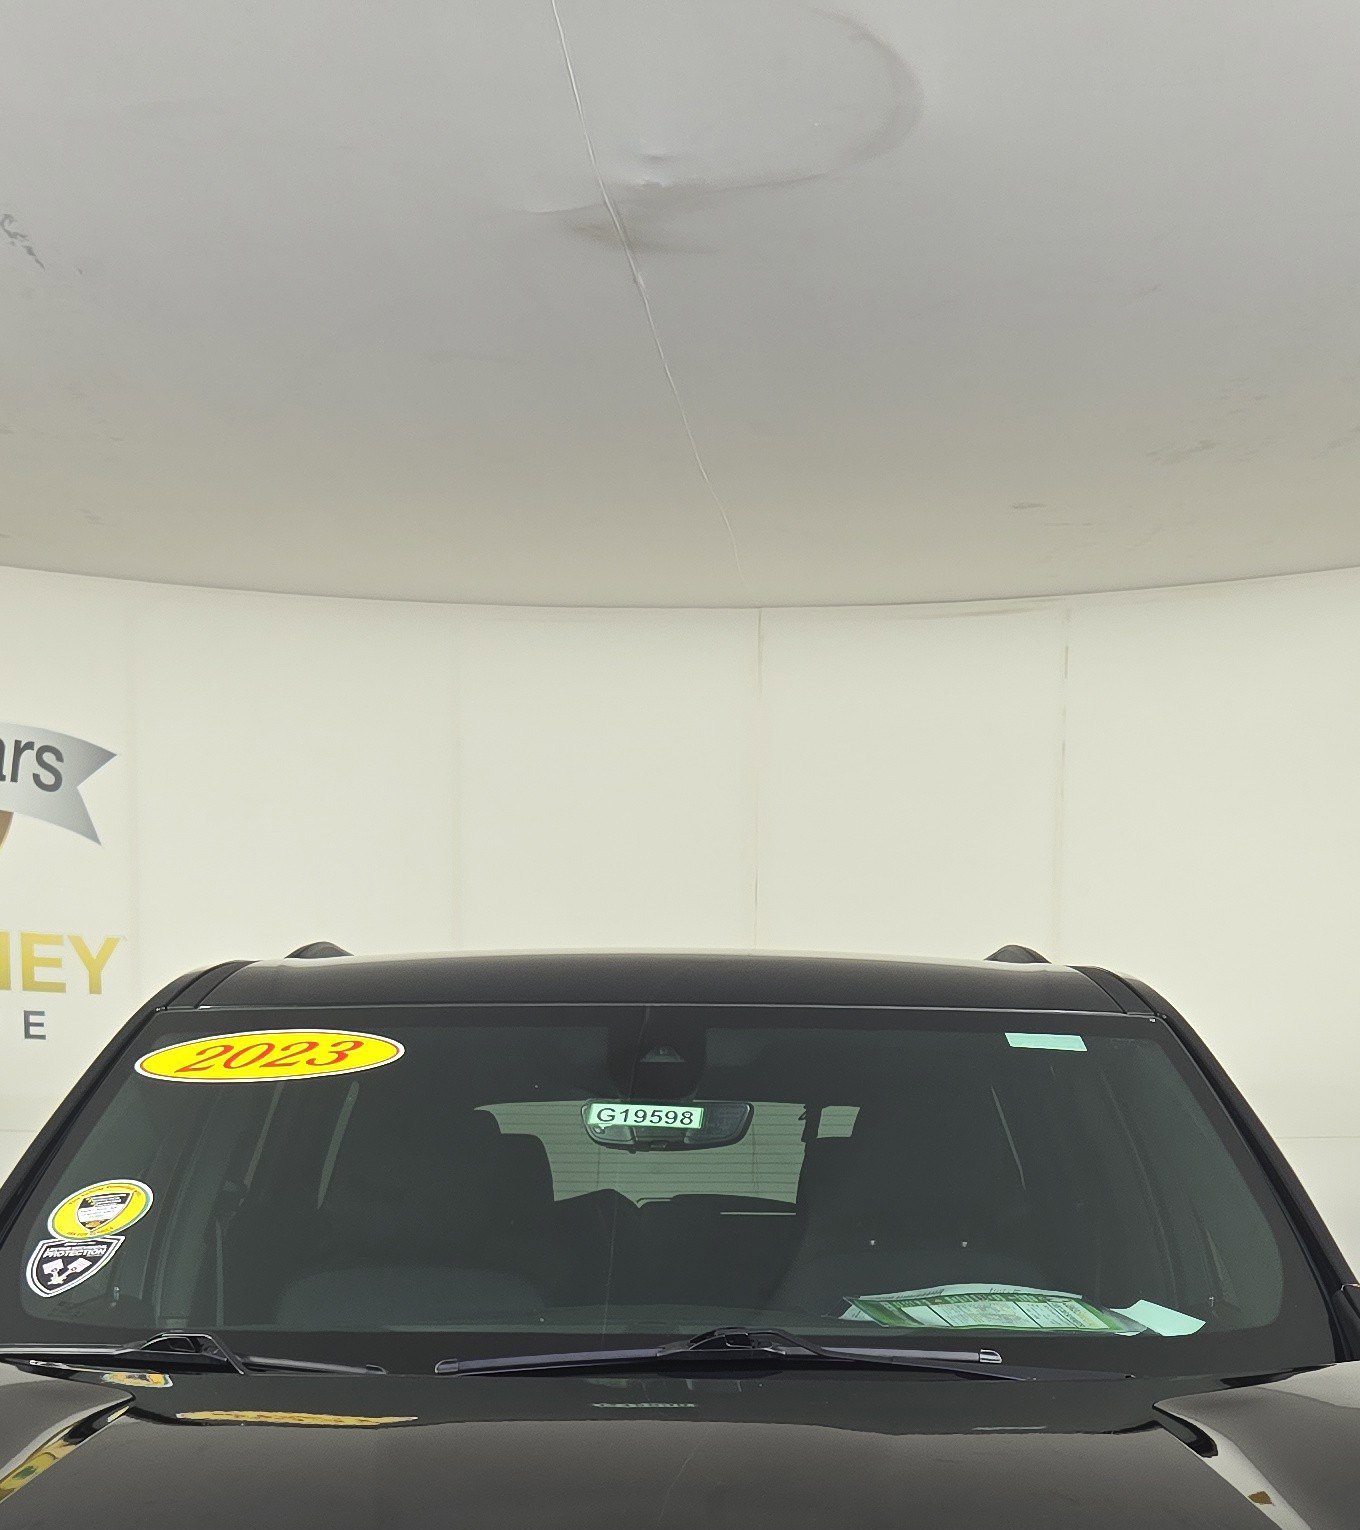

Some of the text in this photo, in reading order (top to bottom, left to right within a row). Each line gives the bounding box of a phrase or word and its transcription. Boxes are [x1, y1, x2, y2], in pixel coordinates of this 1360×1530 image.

[174, 1040, 365, 1073] 2023
[596, 1107, 694, 1125] G19598
[43, 1248, 107, 1258] PROTECTION
